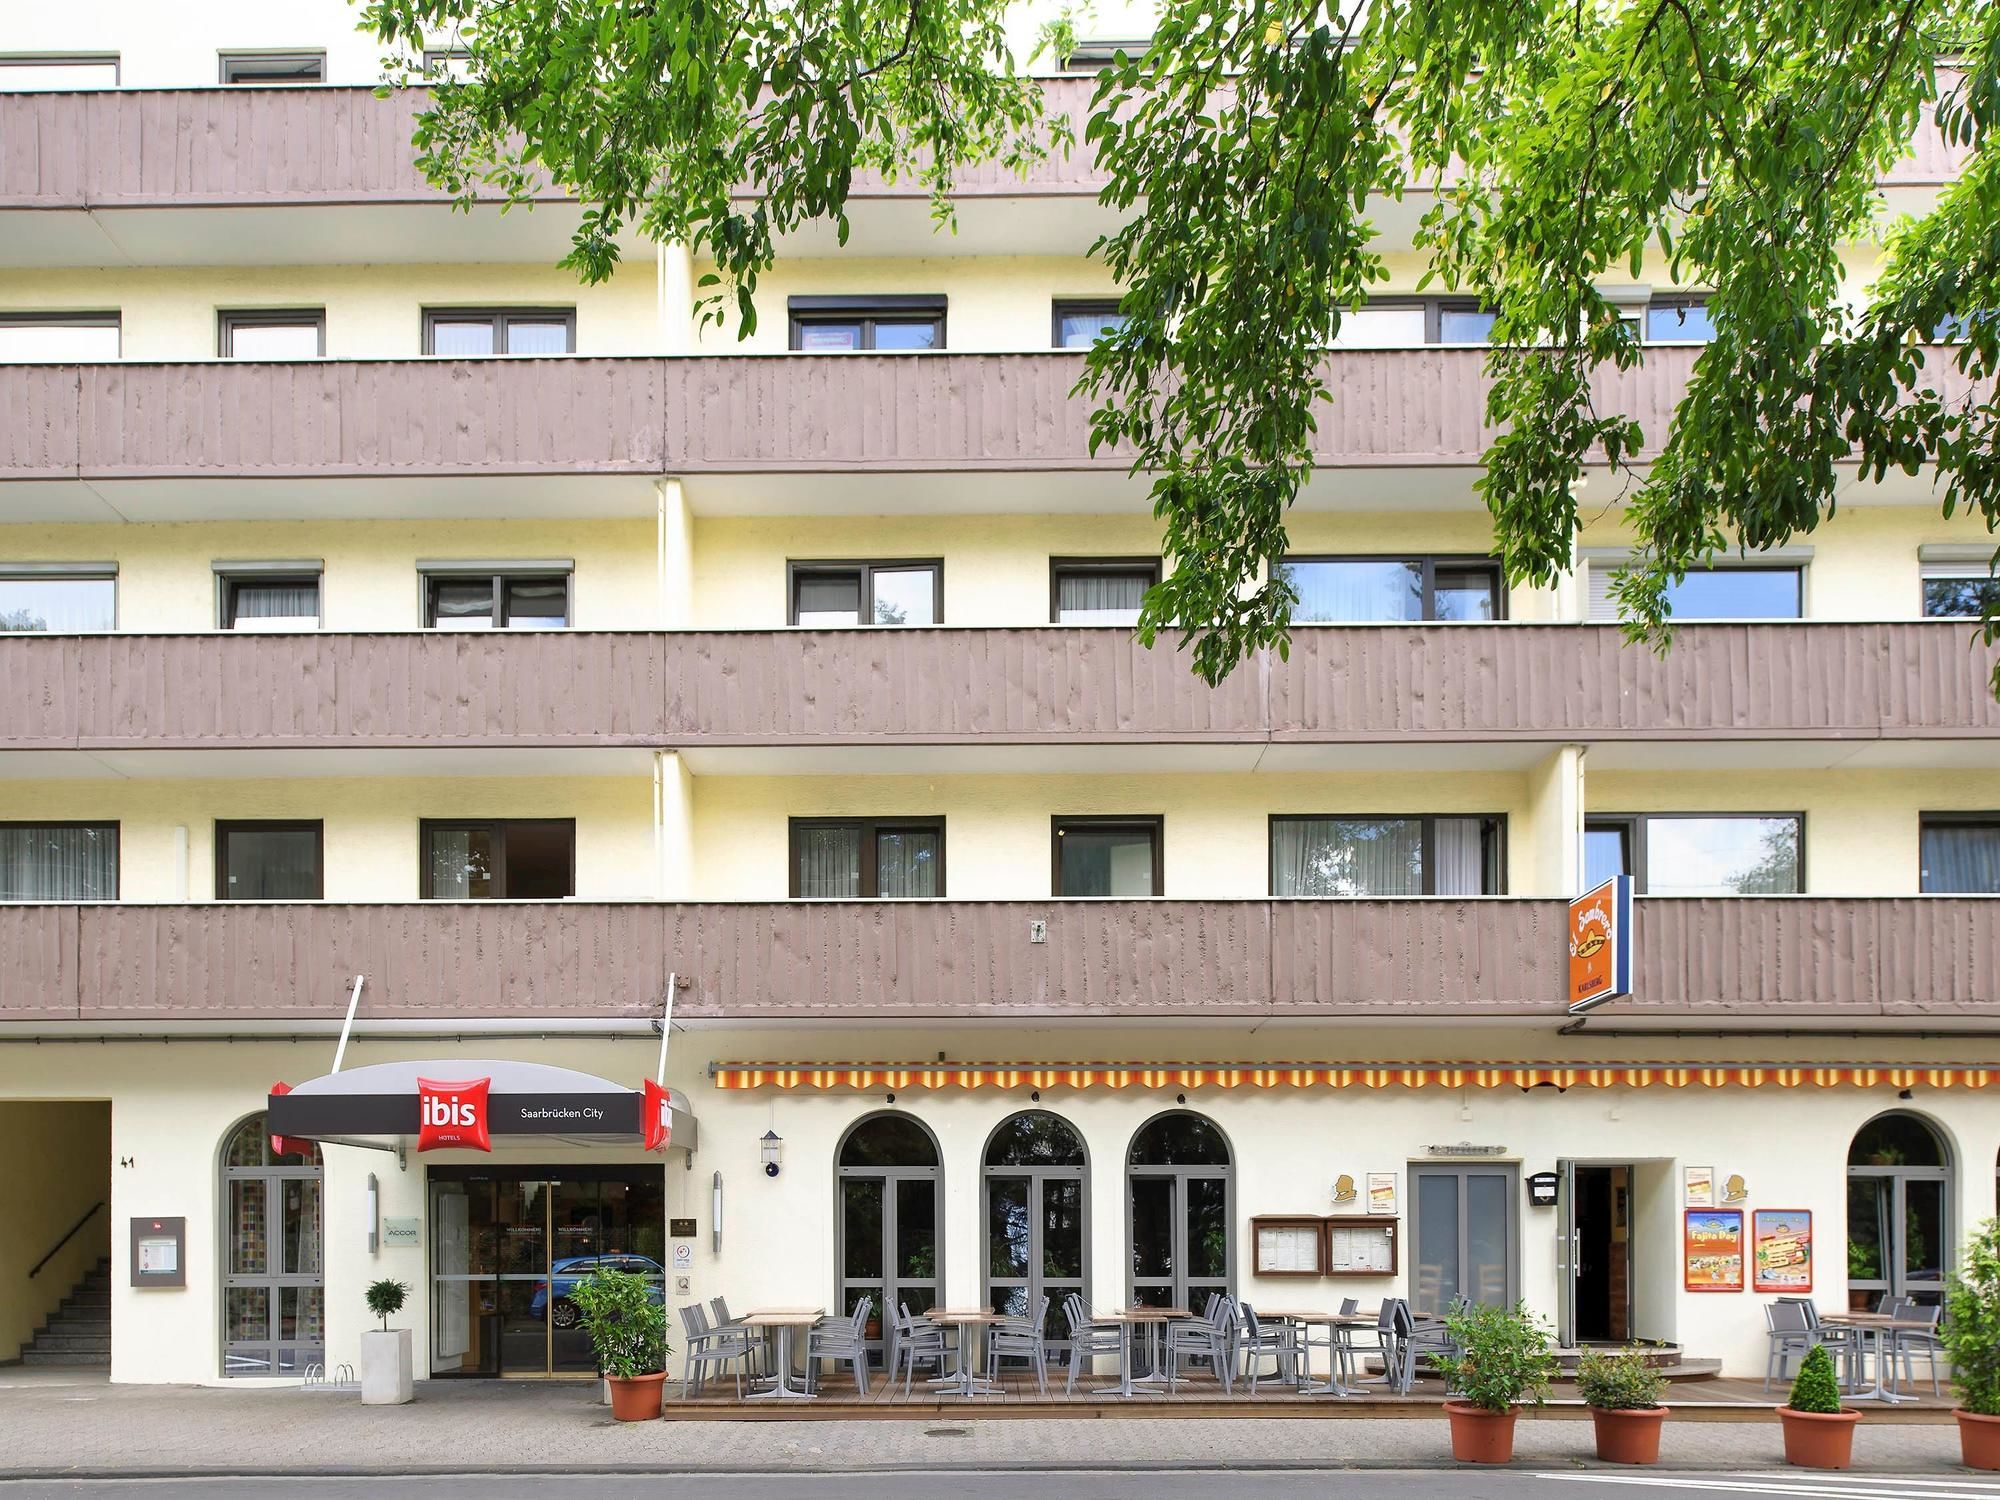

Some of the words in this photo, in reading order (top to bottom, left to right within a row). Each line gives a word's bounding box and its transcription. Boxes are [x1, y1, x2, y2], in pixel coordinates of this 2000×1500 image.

[1570, 931, 1579, 956] El
[1579, 900, 1612, 940] Sombrero
[423, 1096, 476, 1126] ibis
[521, 1108, 581, 1118] Saarbrücken
[584, 1108, 604, 1119] City
[120, 1156, 134, 1168] 41
[1692, 1231, 1718, 1241] Fajita
[1719, 1231, 1737, 1243] Day
